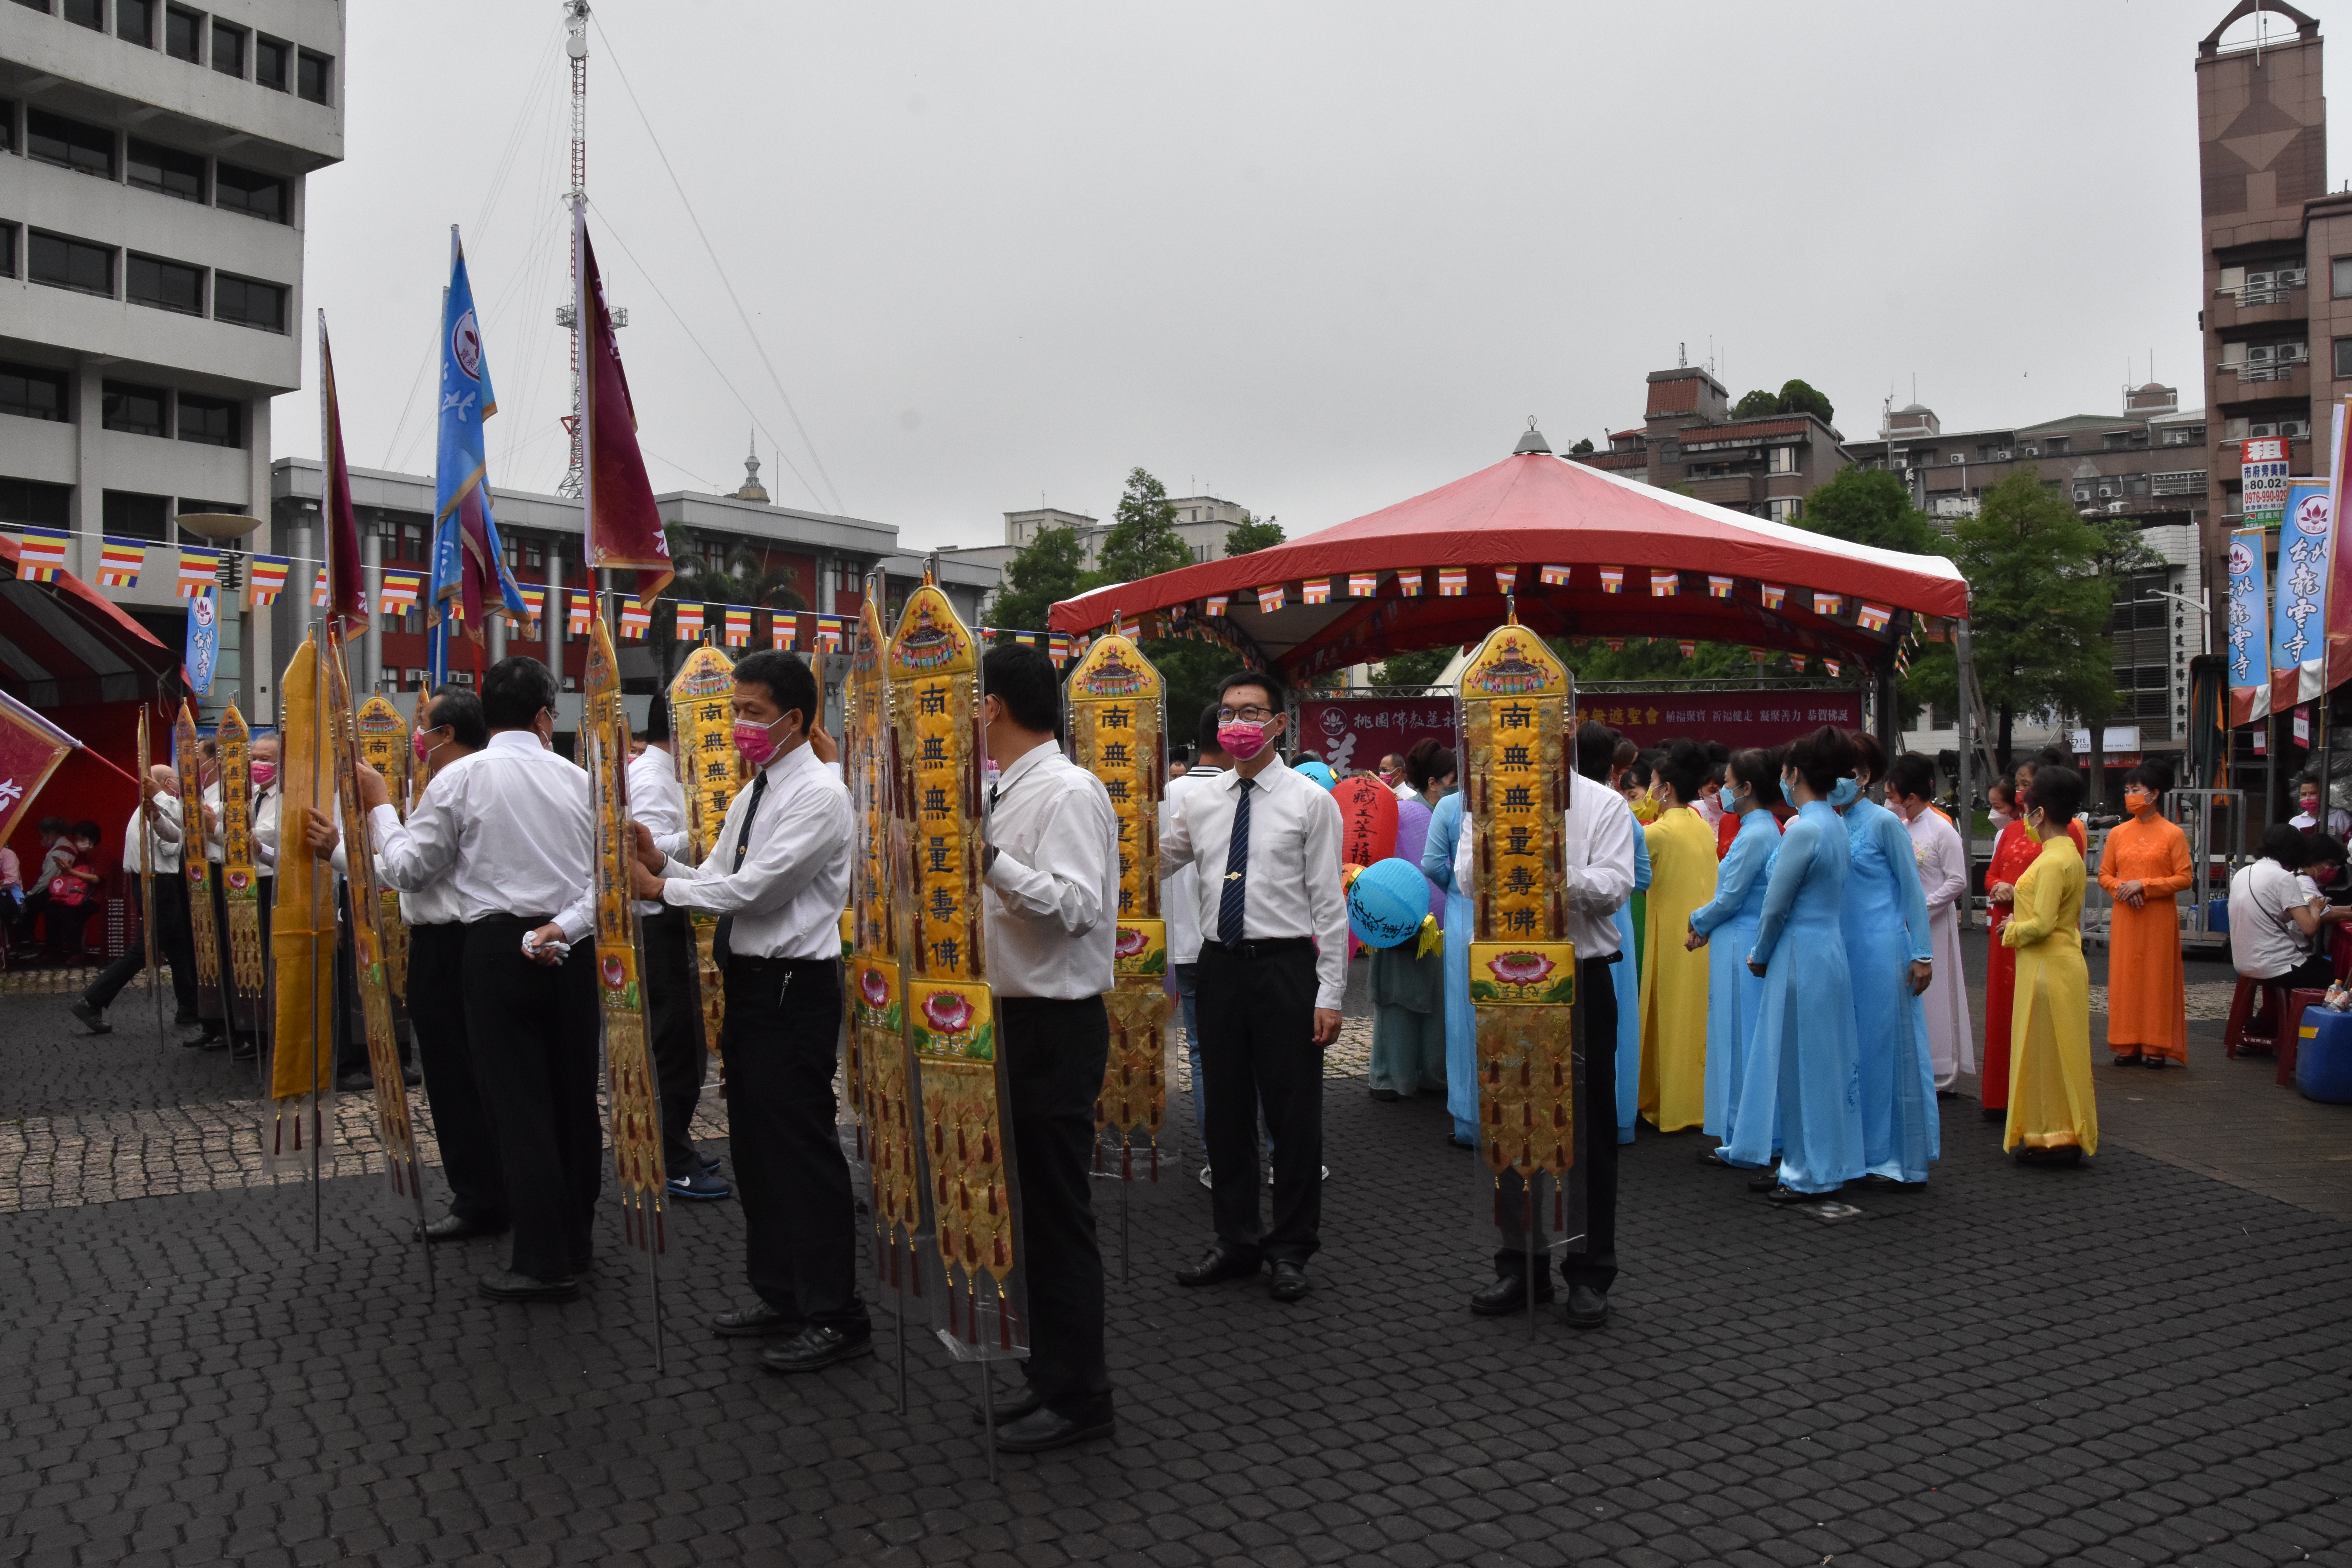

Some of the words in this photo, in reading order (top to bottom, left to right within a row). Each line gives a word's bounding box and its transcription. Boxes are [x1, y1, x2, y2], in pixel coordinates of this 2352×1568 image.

[2248, 441, 2282, 461] 租
[1760, 710, 1801, 722] 凝聚善力
[1808, 709, 1848, 722] 恭賀佛誕
[920, 683, 960, 973] 南無無量壽佛
[1351, 777, 1379, 864] 地藏王菩薩
[1499, 702, 1537, 936] 南無無量壽佛
